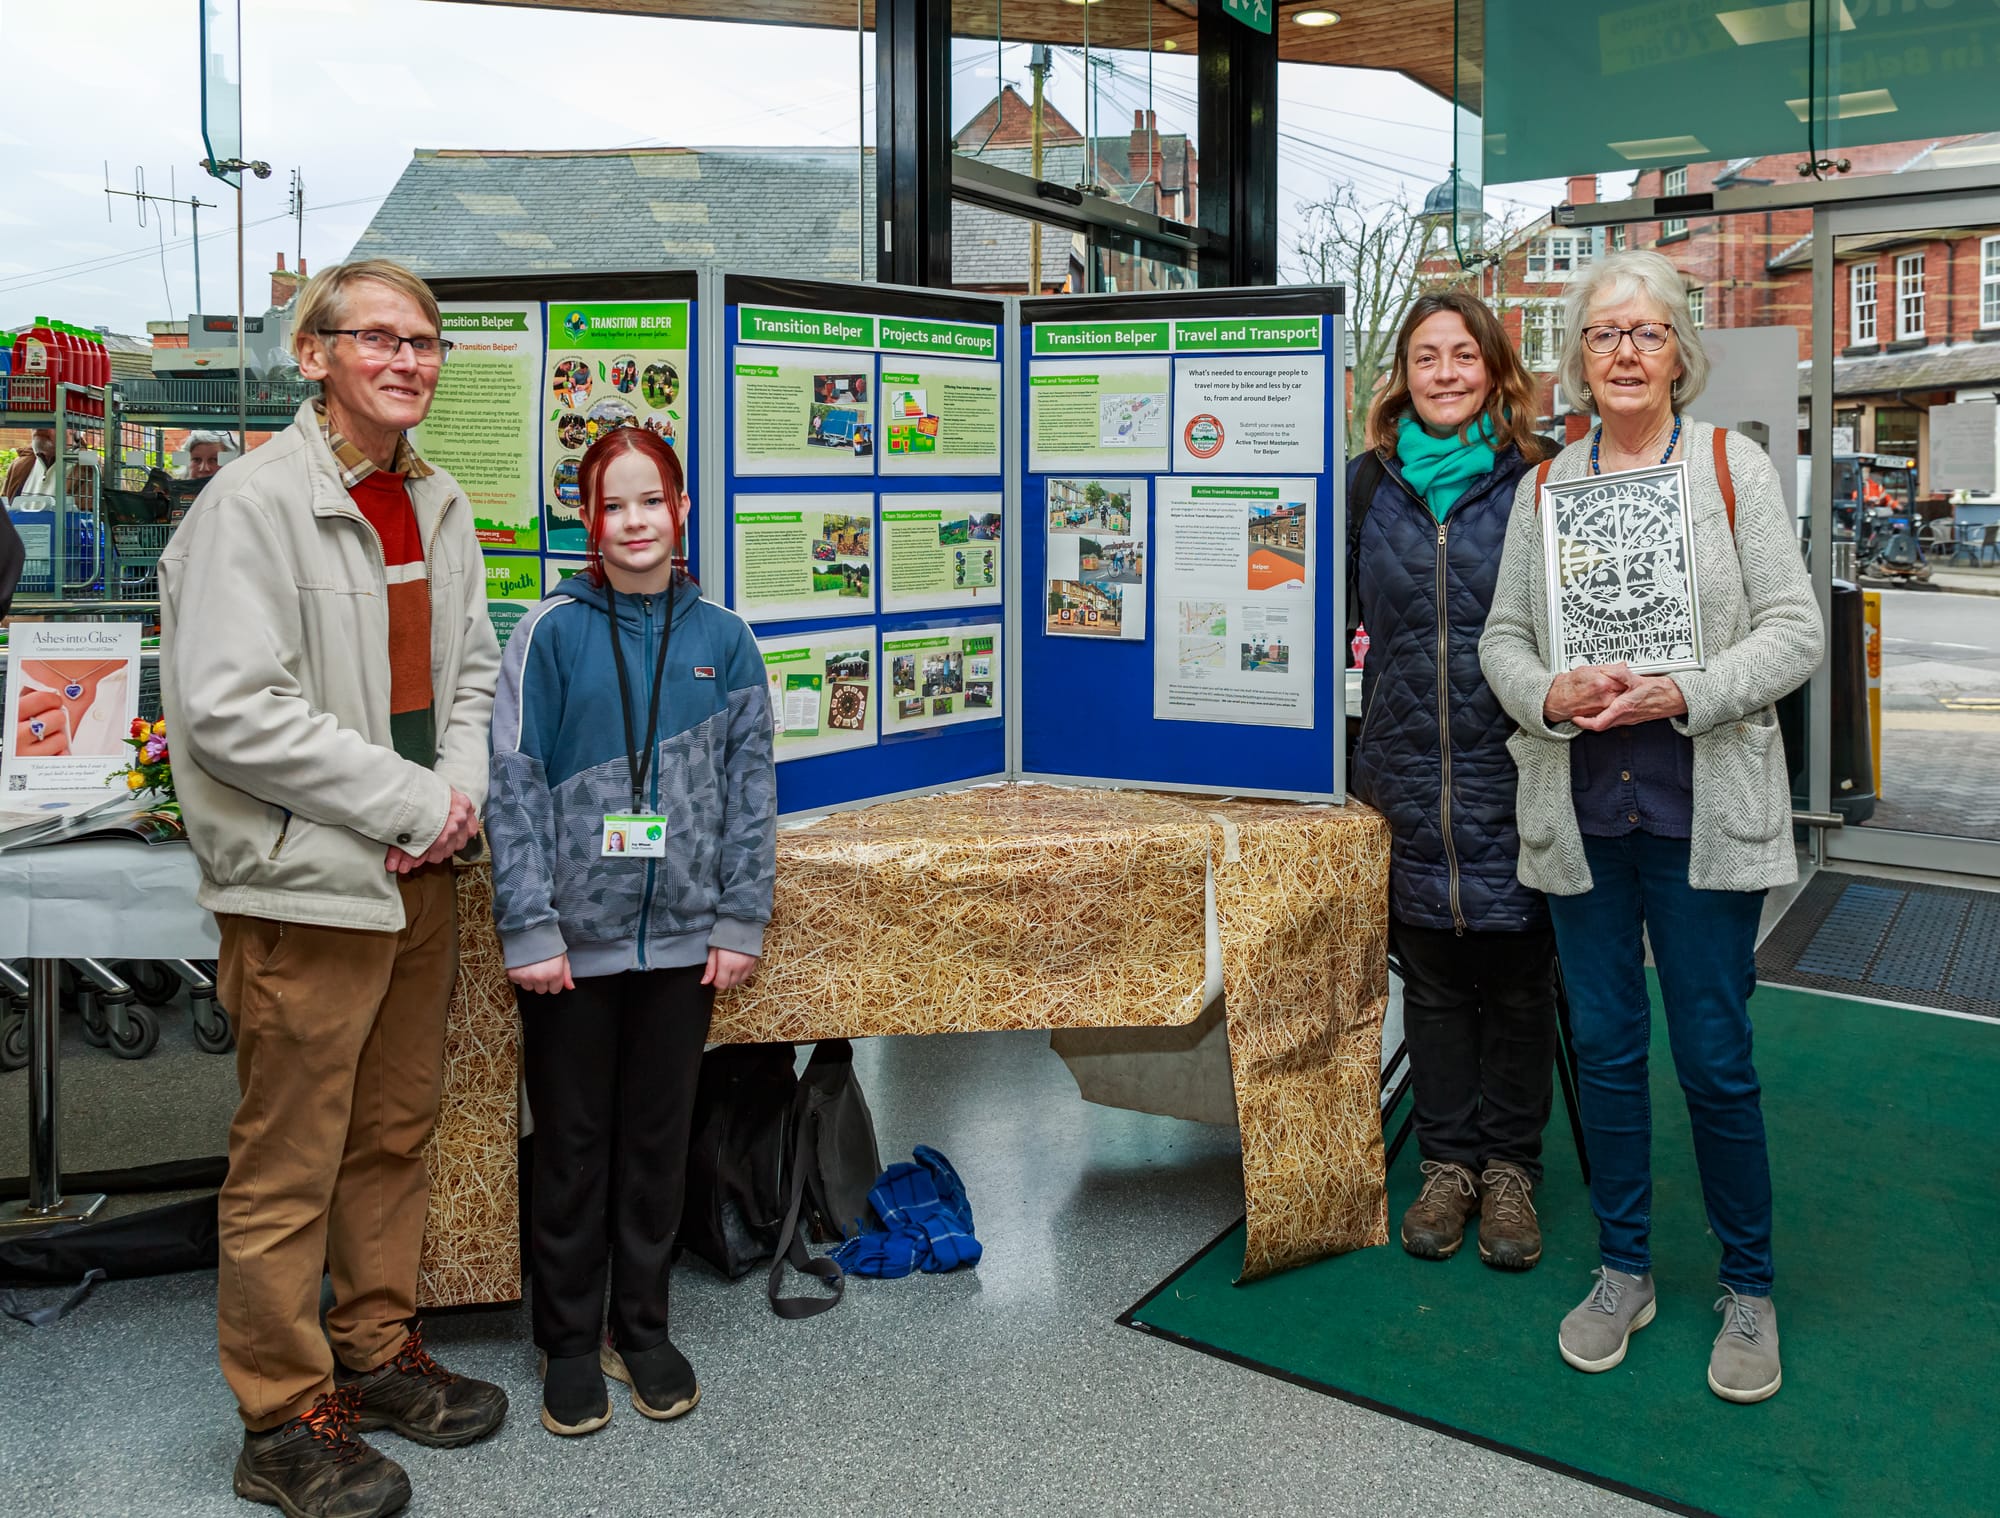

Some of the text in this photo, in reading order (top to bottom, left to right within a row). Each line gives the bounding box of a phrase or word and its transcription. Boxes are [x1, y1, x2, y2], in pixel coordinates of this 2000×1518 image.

[442, 316, 514, 329] ansition Belper
[591, 317, 671, 328] TRANSITION BELPER
[753, 317, 992, 350] Transition Belper Projects and Groups
[1048, 326, 1318, 346] Transition Belper Travel and Transport
[459, 343, 517, 352] Transition Belper?
[739, 367, 774, 375] Energy Group
[1243, 370, 1276, 378] encourage
[1277, 369, 1300, 378] people
[1231, 382, 1240, 391] by
[1282, 382, 1290, 390] by
[1204, 394, 1291, 404] to, from and around Belper?
[1240, 421, 1258, 429] Submit
[1259, 422, 1270, 430] your
[1244, 430, 1273, 438] suggestions
[1270, 439, 1299, 447] Masterplan
[1262, 448, 1280, 456] Belper
[487, 568, 510, 578] ELPER
[500, 573, 535, 596] youth
[1566, 600, 1679, 634] BUSINESS AWARD
[33, 631, 64, 643] Ashes
[67, 634, 87, 643] into
[1565, 627, 1692, 656] TRANSITION BELPER
[782, 651, 806, 660] Transition
